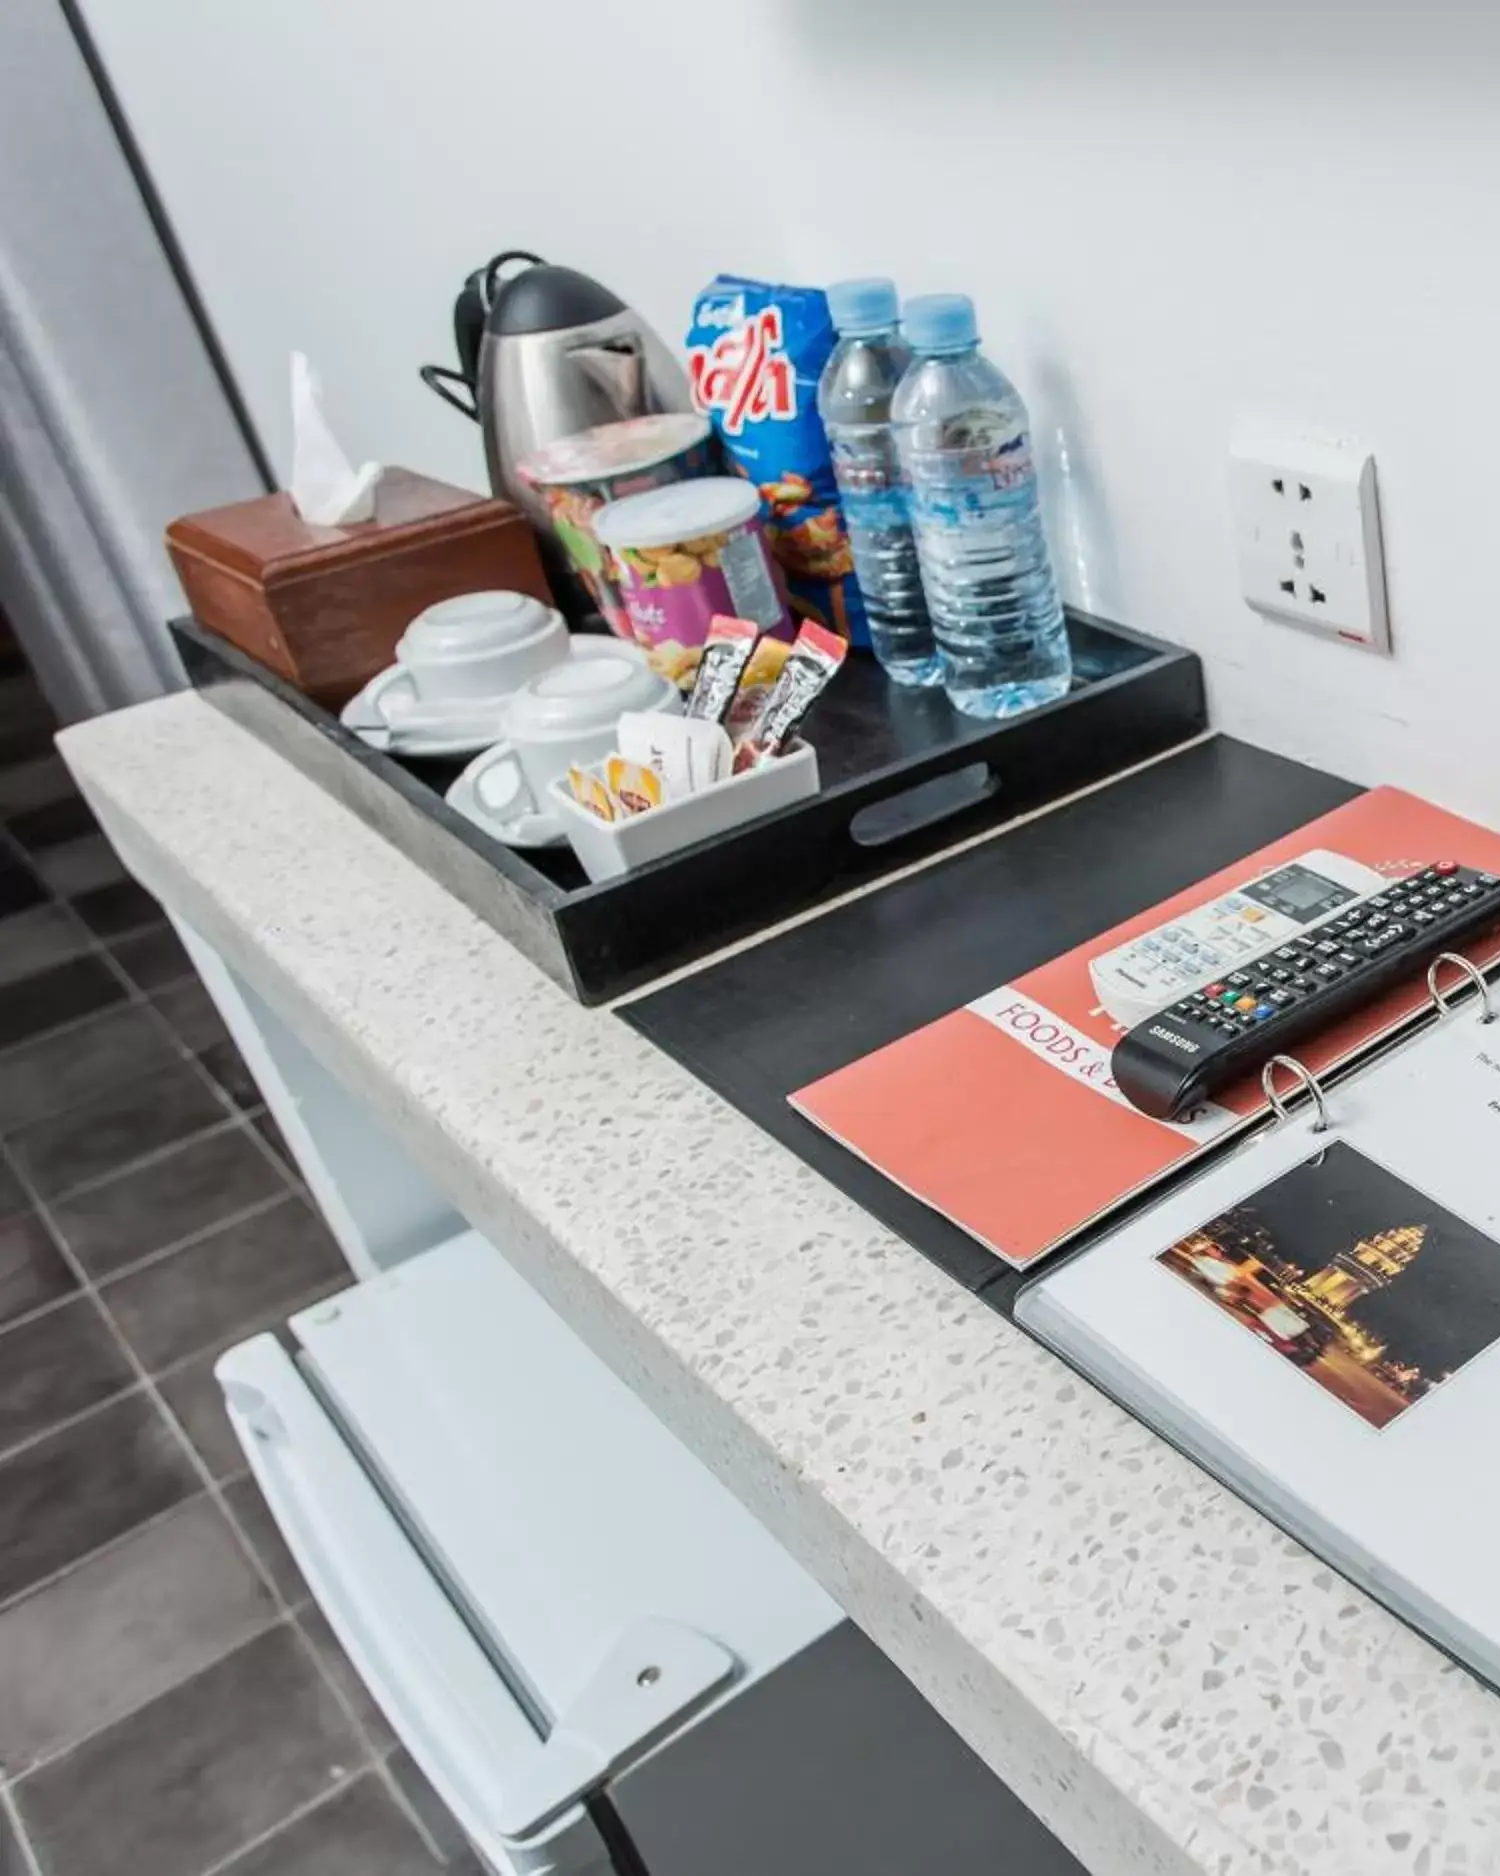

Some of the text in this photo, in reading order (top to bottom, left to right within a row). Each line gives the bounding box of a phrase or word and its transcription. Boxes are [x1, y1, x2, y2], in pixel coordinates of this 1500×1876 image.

[997, 1003, 1106, 1077] FOODS &
[1149, 1025, 1200, 1053] SAMSUNG
